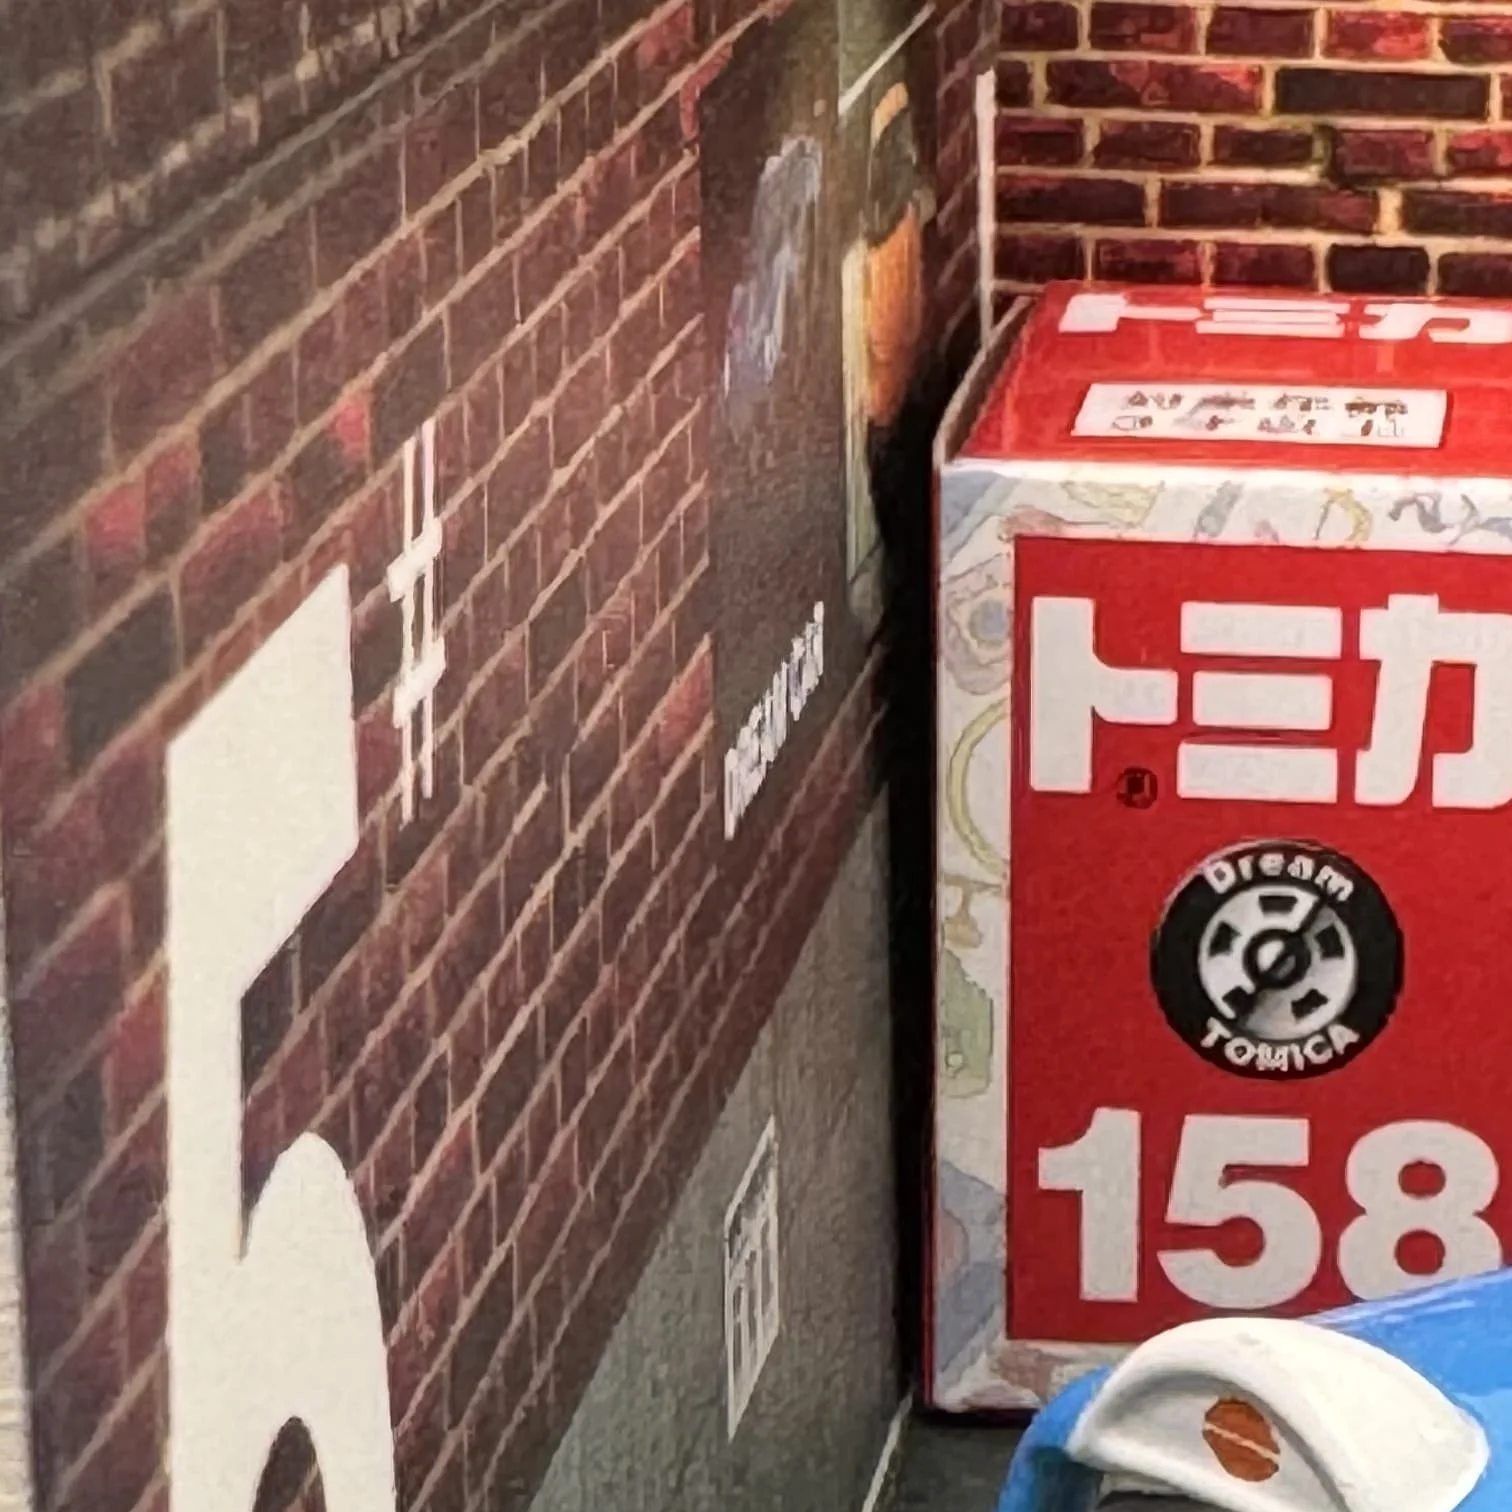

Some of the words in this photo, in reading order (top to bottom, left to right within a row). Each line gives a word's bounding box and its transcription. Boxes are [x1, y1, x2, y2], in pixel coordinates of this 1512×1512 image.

[1203, 851, 1355, 902] Dream
[1200, 1016, 1361, 1073] TOMICA
[1037, 1106, 1503, 1310] 158
